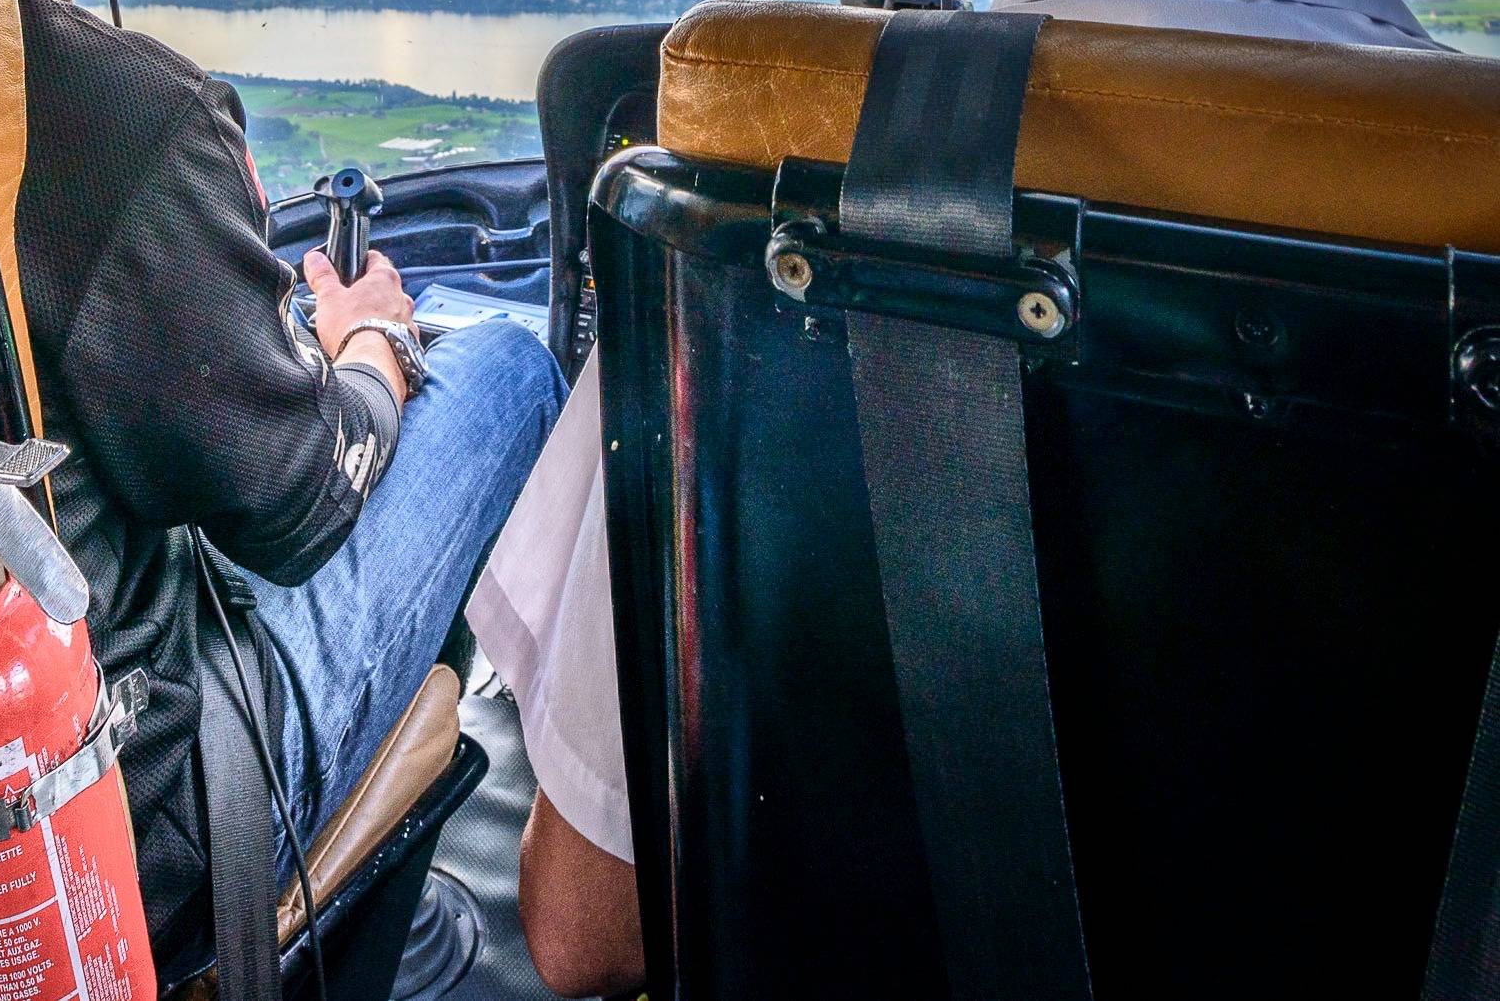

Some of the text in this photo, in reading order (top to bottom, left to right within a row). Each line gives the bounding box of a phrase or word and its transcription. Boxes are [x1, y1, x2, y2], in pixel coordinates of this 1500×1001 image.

[9, 871, 37, 890] FULLY
[15, 921, 33, 934] 1000
[33, 917, 41, 927] V.
[3, 938, 13, 947] 50
[13, 936, 28, 945] cm.
[7, 945, 23, 957] AUX
[23, 938, 43, 952] GAZ.
[11, 950, 40, 966] USAGE.
[9, 970, 26, 981] 1000
[27, 959, 54, 976] VOLTS.
[13, 986, 42, 1000] GASES.
